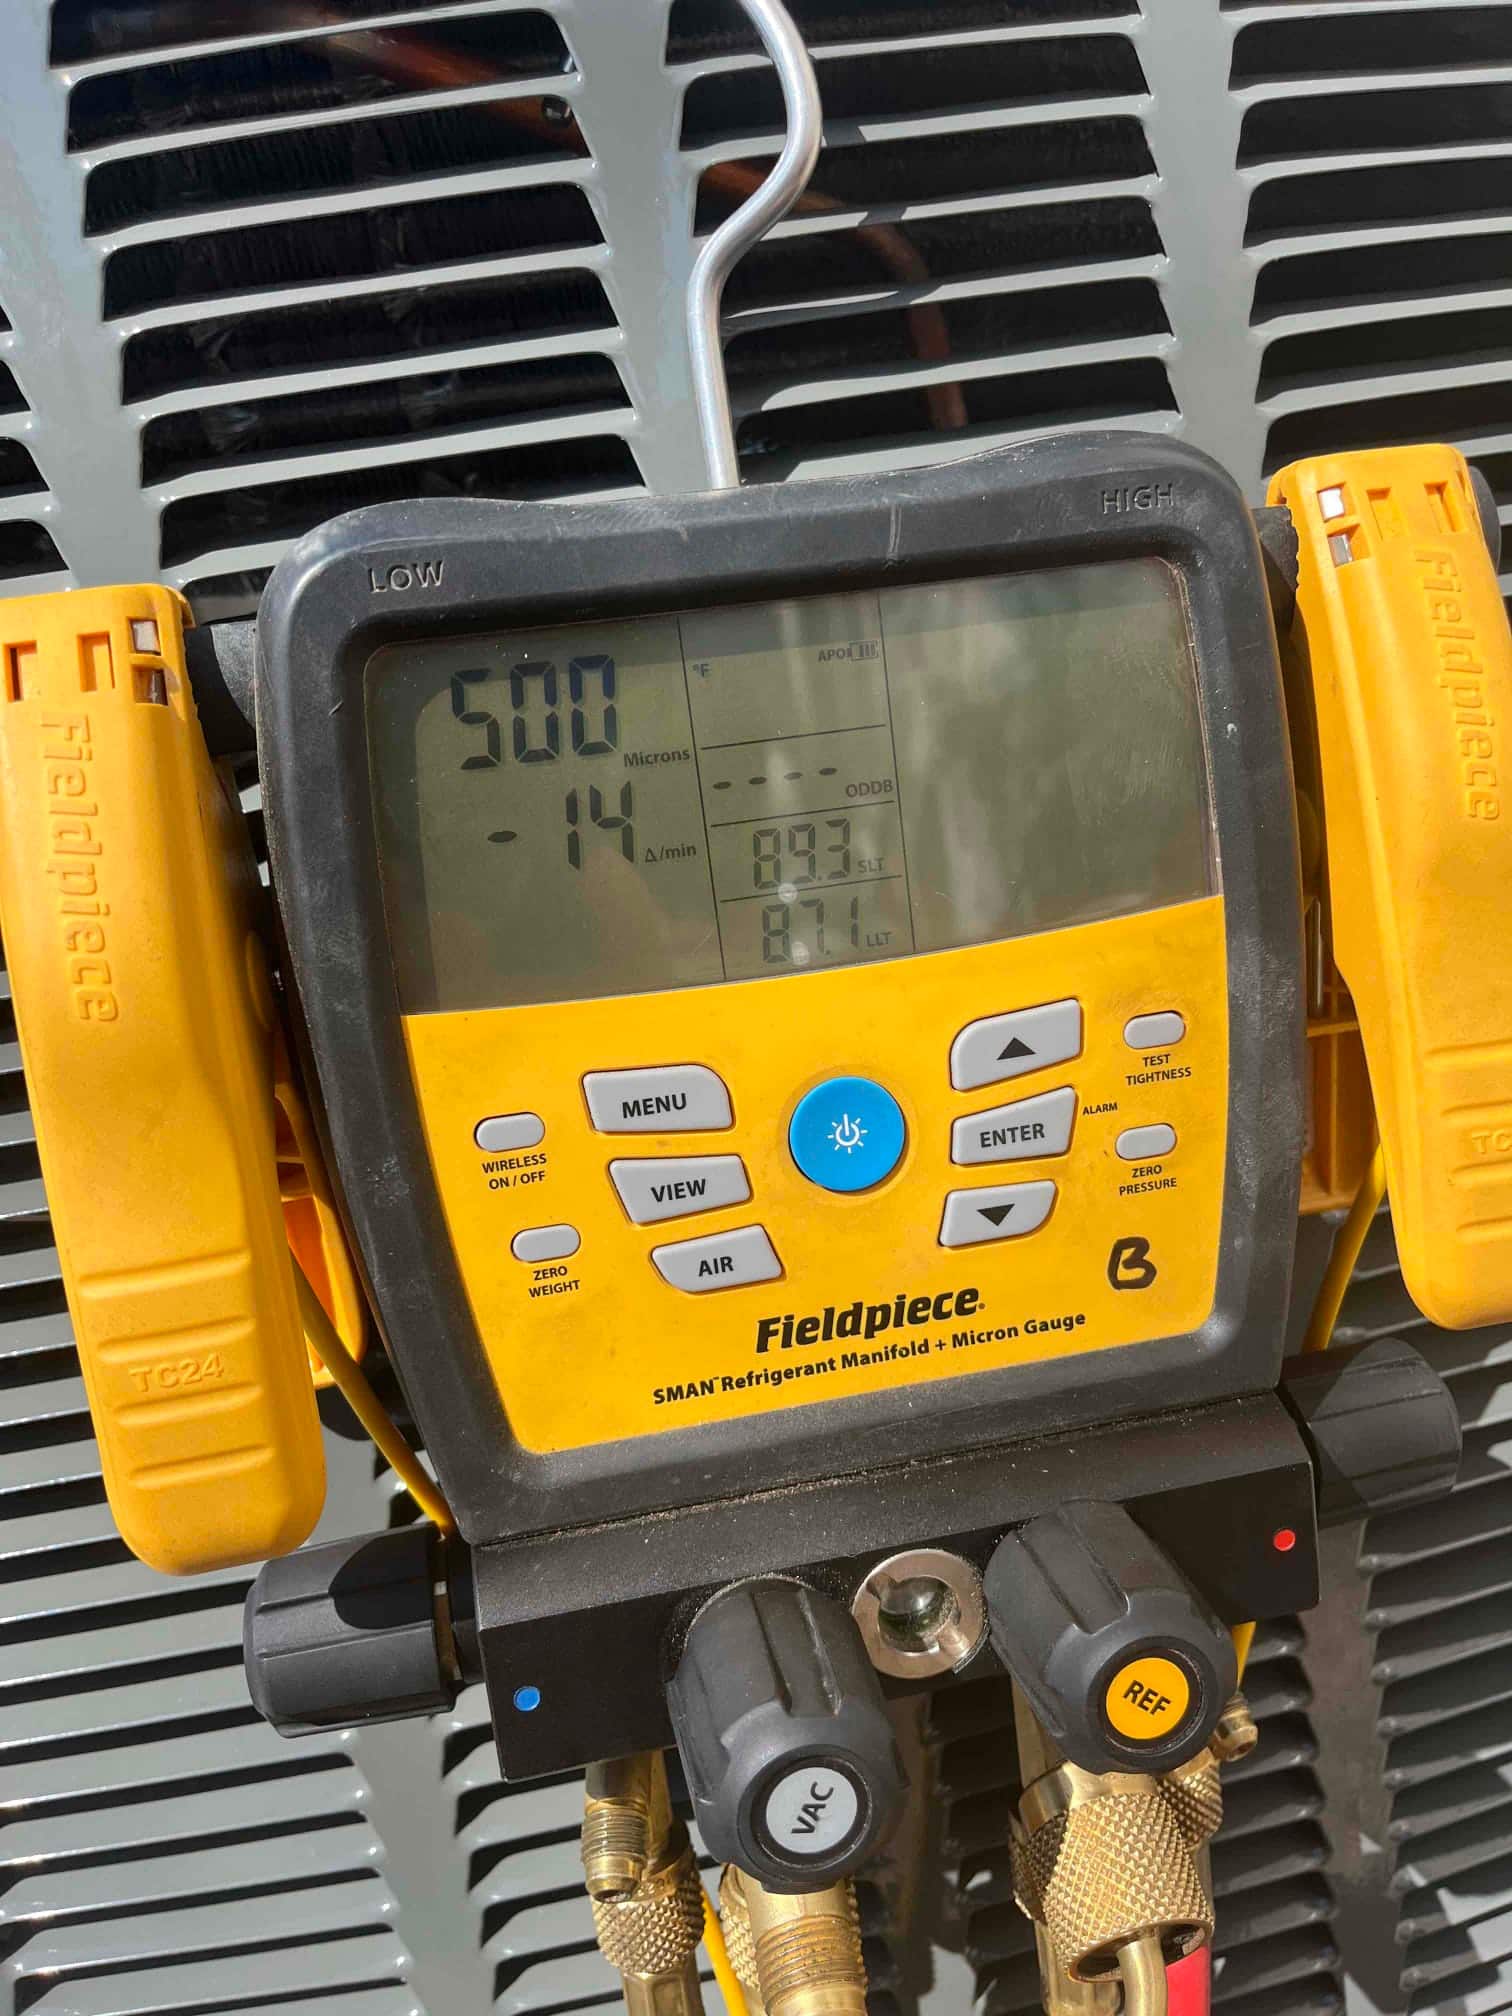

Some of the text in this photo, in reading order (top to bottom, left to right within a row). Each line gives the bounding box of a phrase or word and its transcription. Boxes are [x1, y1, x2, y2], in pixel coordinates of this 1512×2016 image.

[1102, 483, 1174, 514] HIGH
[368, 559, 444, 594] LOW
[1416, 549, 1500, 822] Fieldpiece
[450, 654, 617, 770] 500
[623, 748, 690, 768] Microns
[845, 779, 894, 798] ODDB
[40, 713, 120, 1024] Fieldpiece
[857, 857, 885, 873] SLT
[866, 932, 892, 947] LLT
[1143, 1054, 1171, 1067] TEST
[1126, 1067, 1192, 1086] TIGHTNESS
[622, 1093, 687, 1119] MENU
[1082, 1102, 1118, 1116] ALARM
[980, 1123, 1045, 1148] ENTER
[482, 1153, 547, 1174] WIRELESS
[1132, 1165, 1162, 1178] ZERO
[489, 1175, 510, 1190] ON
[520, 1171, 547, 1185] OFF
[650, 1178, 707, 1203] VIEW
[1119, 1177, 1177, 1196] PRESSURE
[532, 1265, 568, 1281] ZERO
[698, 1256, 735, 1277] AIR
[1107, 1236, 1158, 1290] B
[528, 1279, 581, 1299] WEIGHT
[756, 1287, 979, 1354] Fieldpiece
[720, 1357, 837, 1392] Refrigerant
[841, 1338, 931, 1368] Manifold
[952, 1324, 1019, 1349] Micron
[1023, 1312, 1087, 1336] Gauge
[130, 1353, 225, 1393] TC24
[1122, 1680, 1172, 1716] REF
[791, 1781, 835, 1836] VAC
